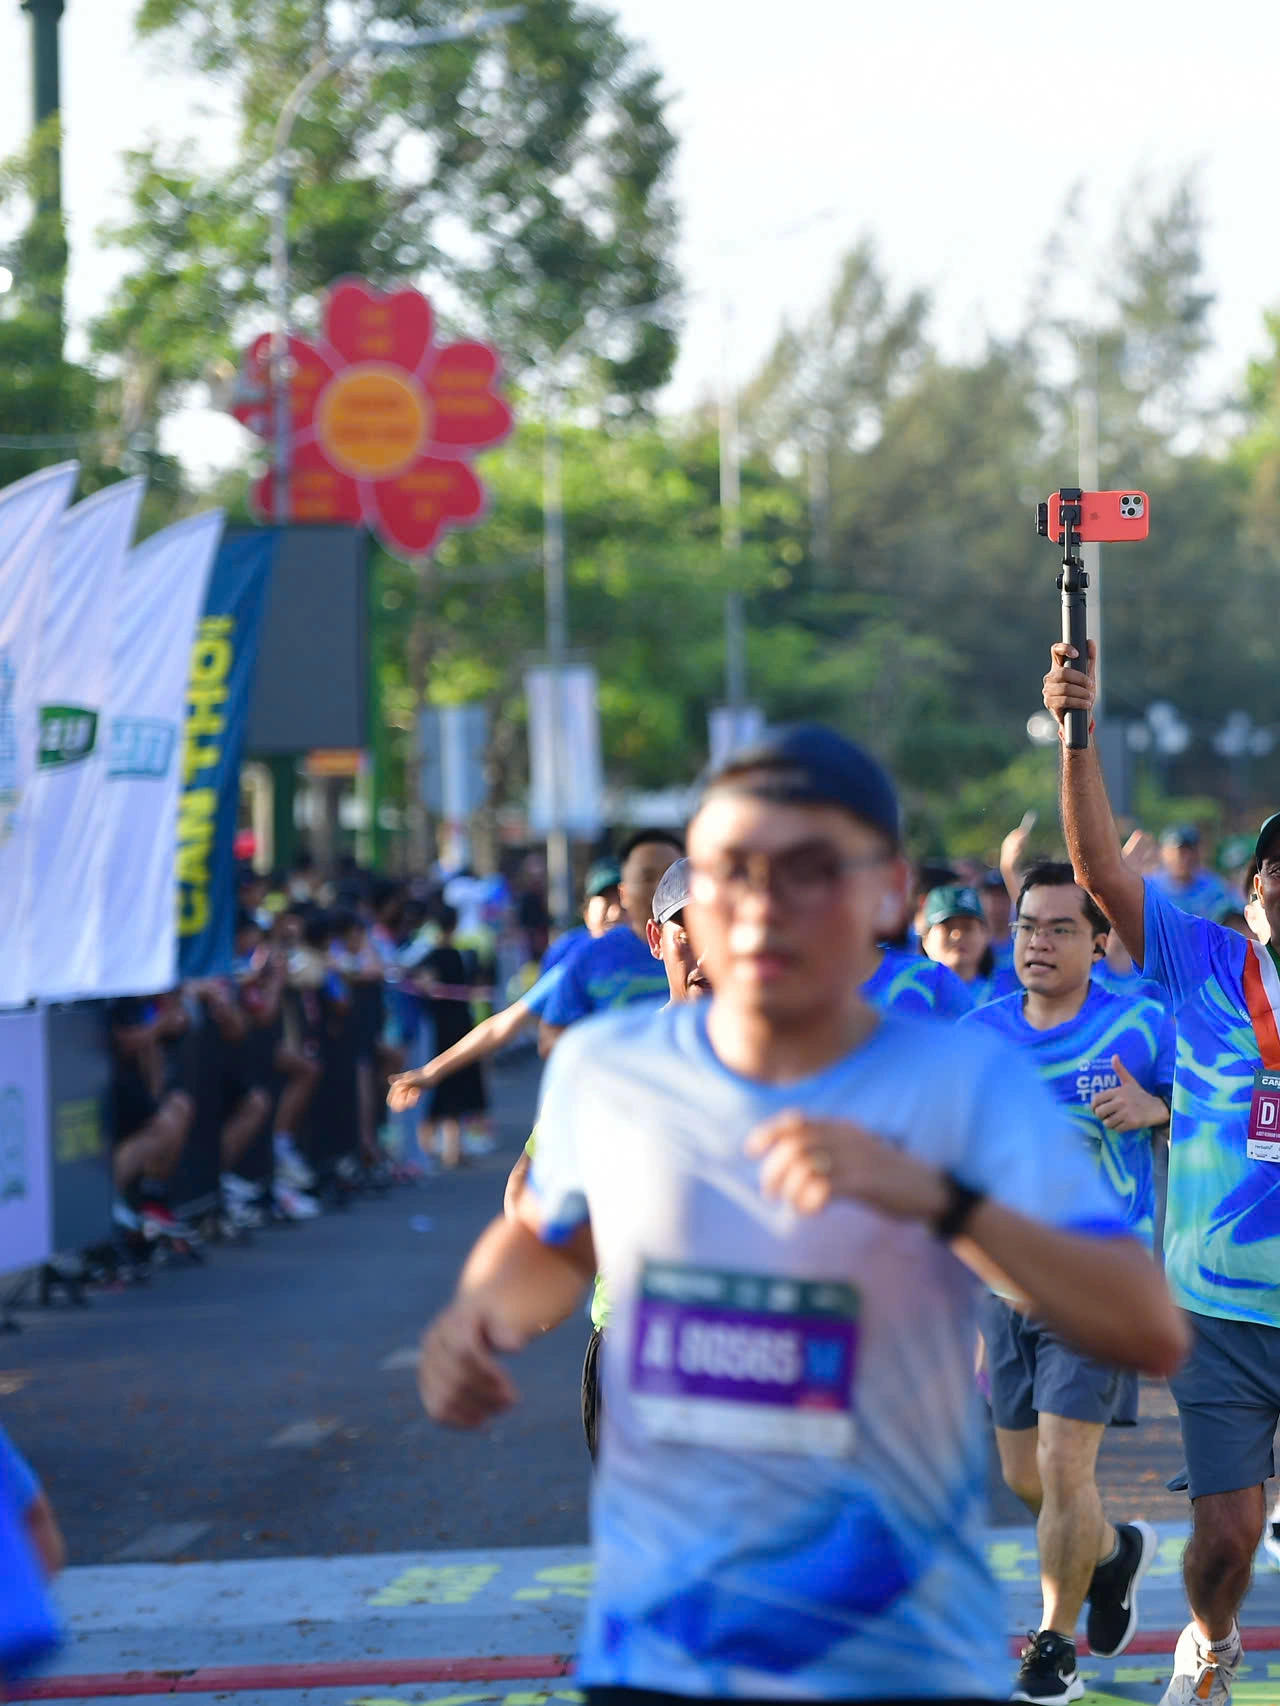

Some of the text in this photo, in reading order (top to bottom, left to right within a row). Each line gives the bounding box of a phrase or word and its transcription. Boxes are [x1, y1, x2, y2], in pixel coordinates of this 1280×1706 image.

[1075, 1074, 1117, 1090] CAN
[1262, 1079, 1280, 1087] CAN
[1260, 1101, 1275, 1125] D
